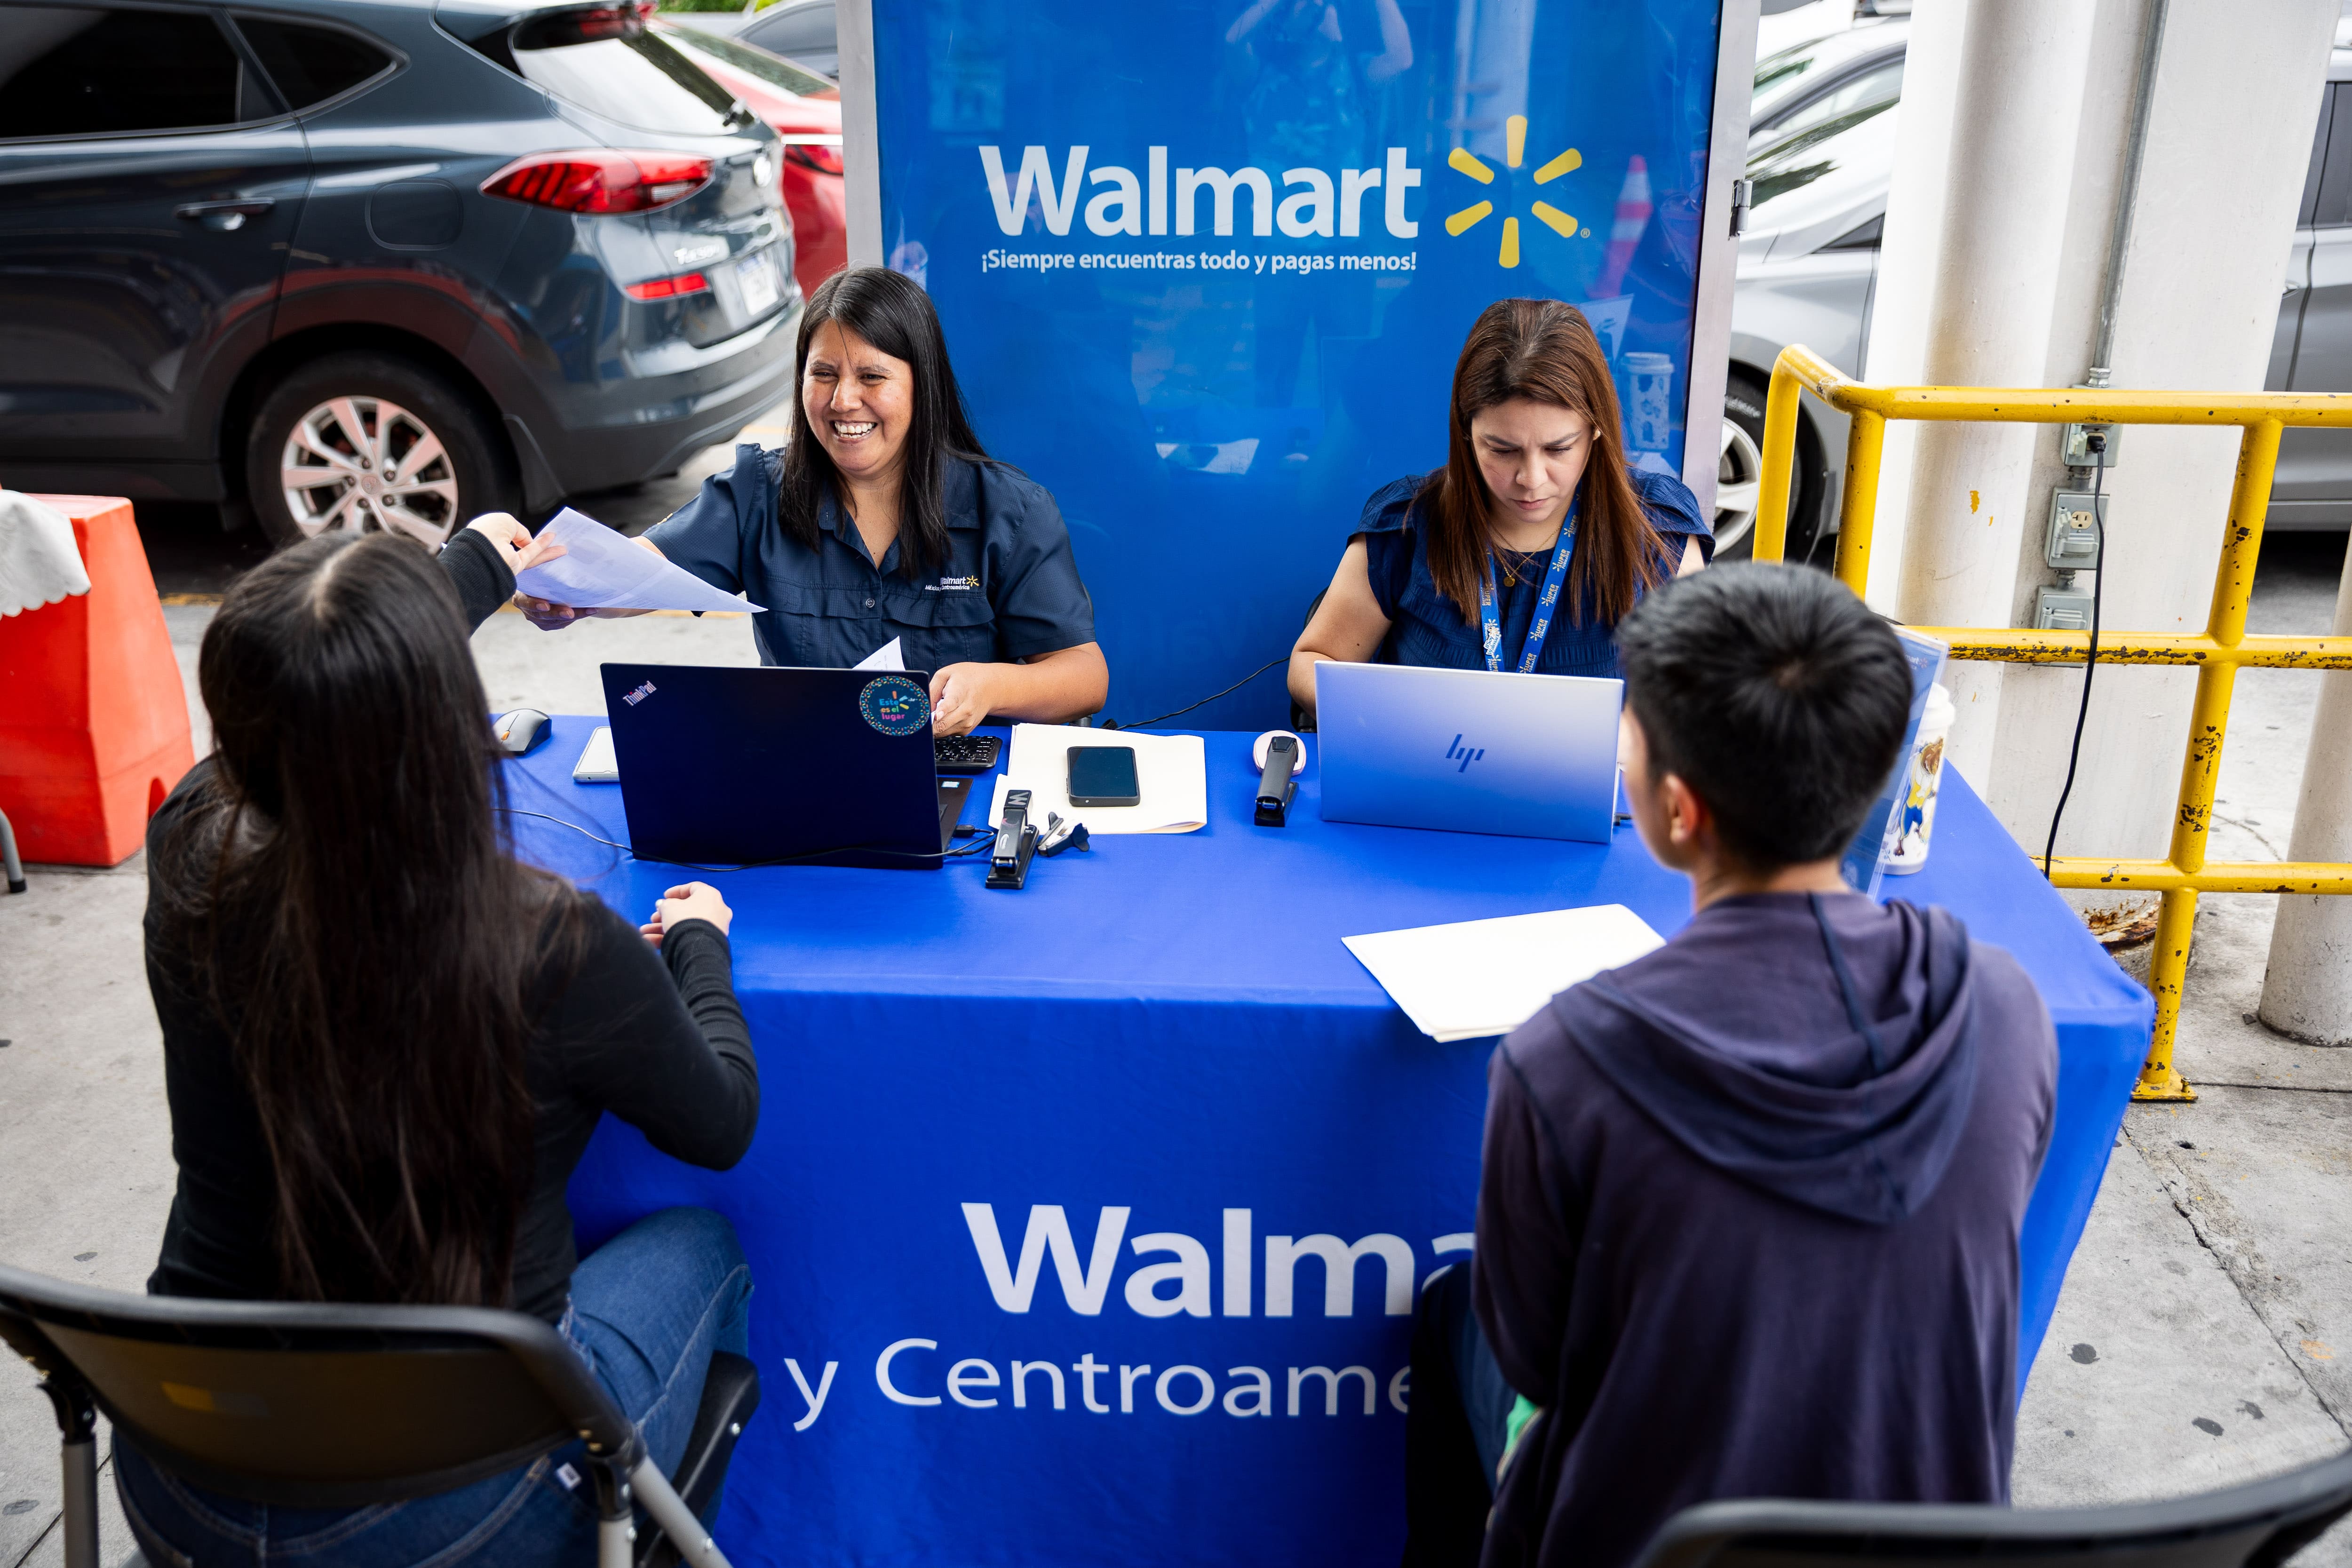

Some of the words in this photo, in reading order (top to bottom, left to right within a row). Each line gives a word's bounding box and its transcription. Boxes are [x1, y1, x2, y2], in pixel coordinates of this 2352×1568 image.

[979, 145, 1421, 239] Walmart
[982, 249, 1075, 273] ¡Siempre
[1079, 252, 1195, 269] encuentras
[1200, 249, 1250, 270] todo
[1254, 255, 1267, 275] y
[1271, 255, 1335, 275] pagas
[1340, 252, 1416, 271] menos!
[1557, 549, 1566, 568] SUPER
[1545, 584, 1555, 603] SUPER
[1534, 618, 1544, 637] SUPER
[1524, 653, 1533, 671] SUPER
[622, 680, 657, 706] ThinkPad
[882, 713, 905, 722] lugar
[784, 1358, 839, 1432] y
